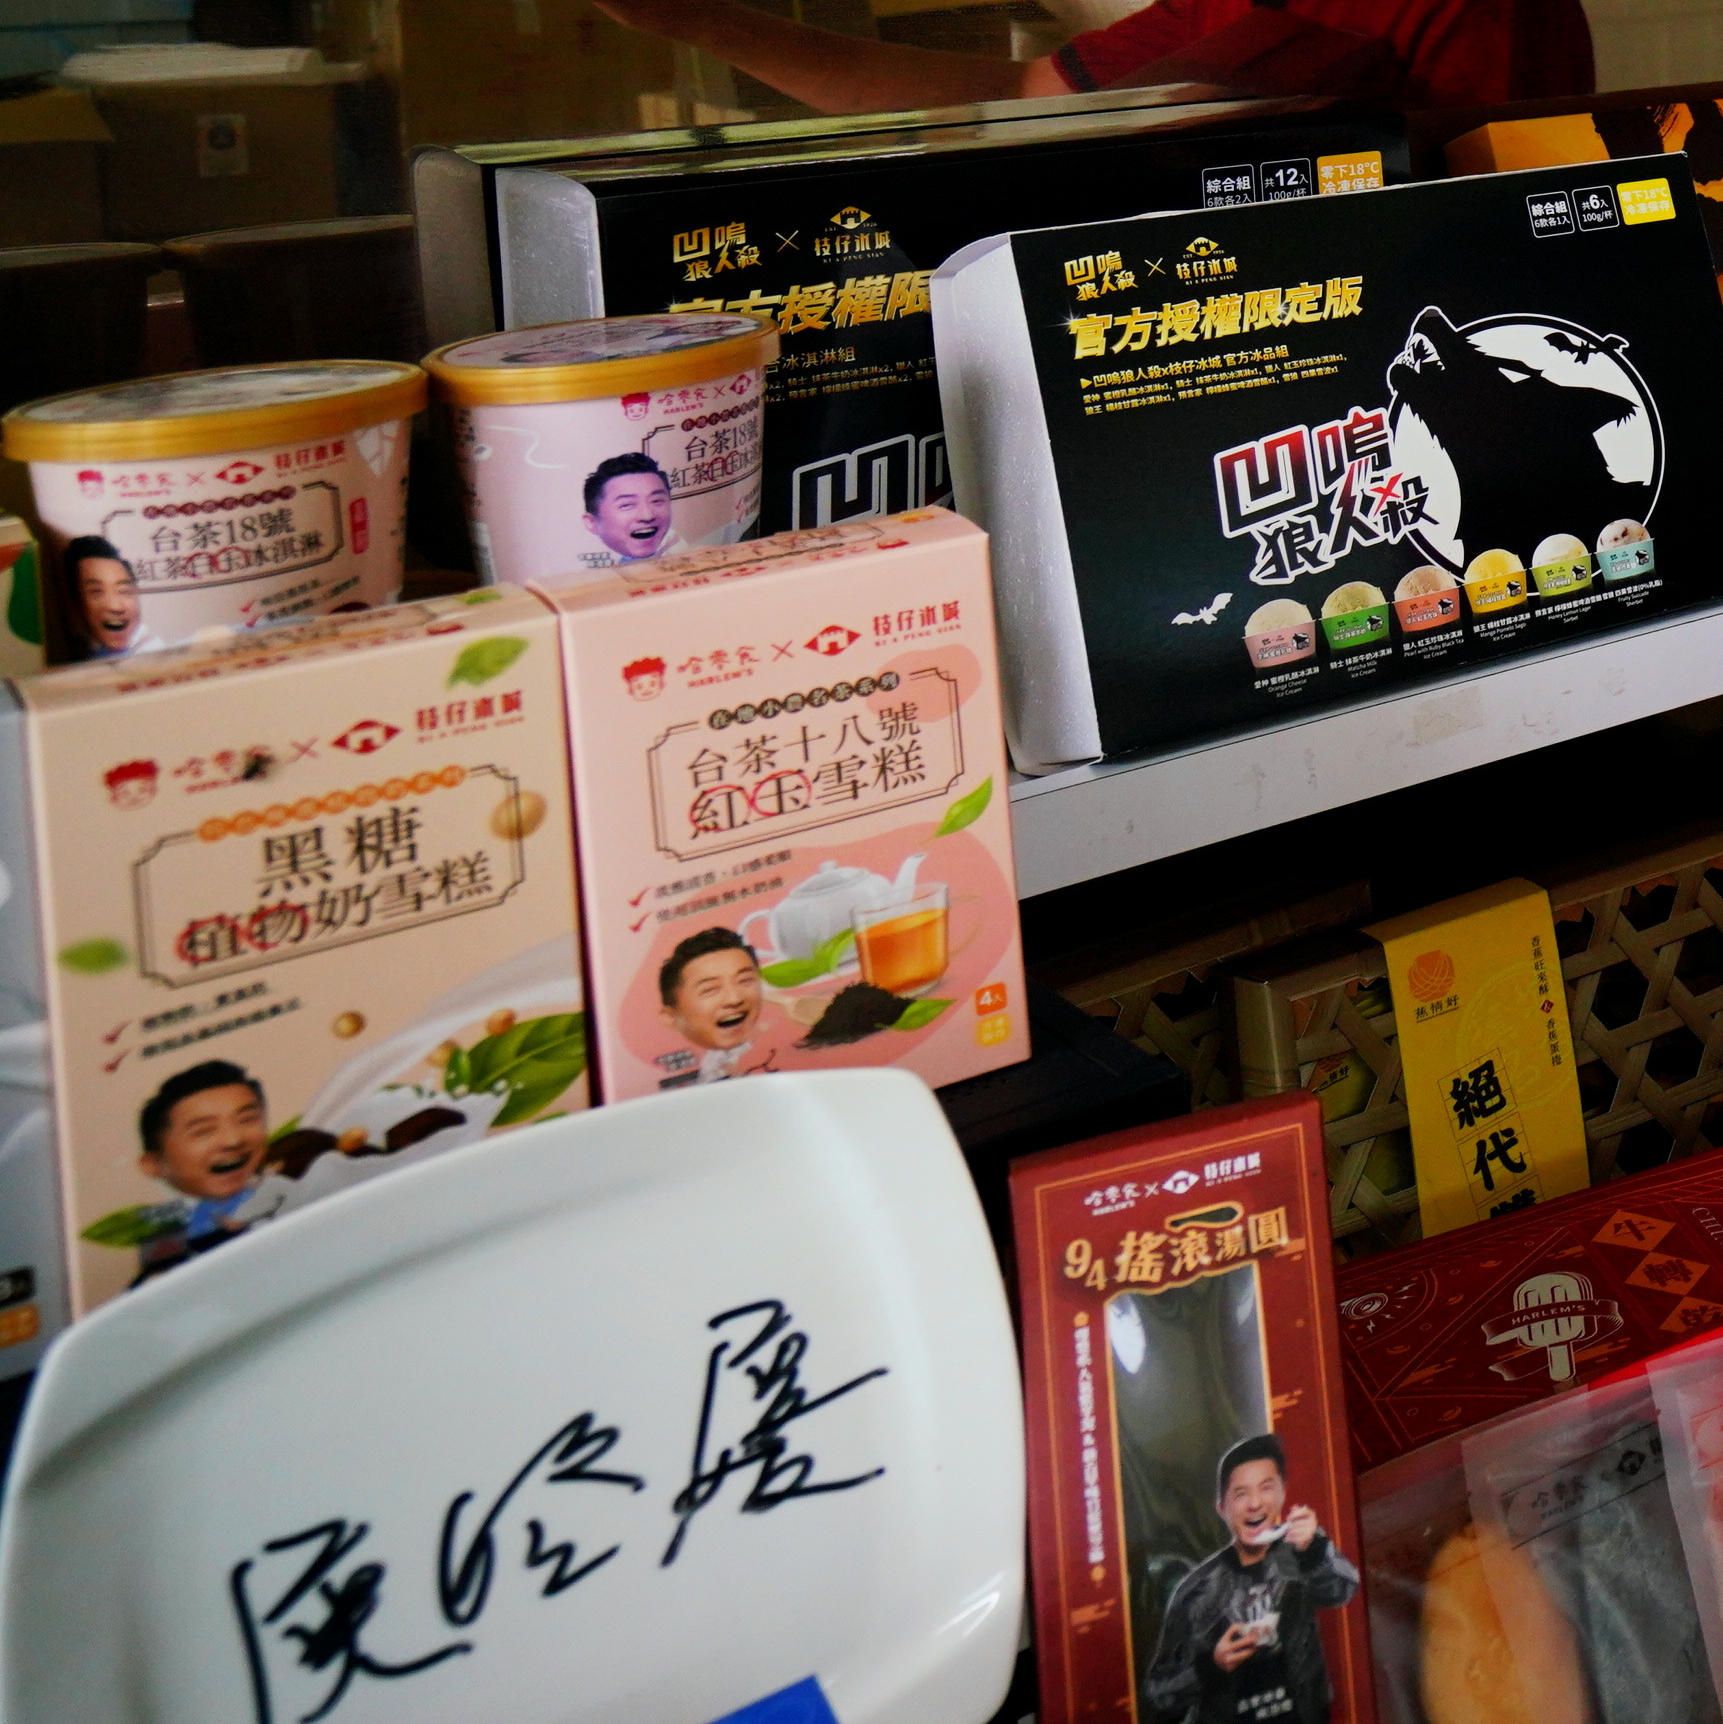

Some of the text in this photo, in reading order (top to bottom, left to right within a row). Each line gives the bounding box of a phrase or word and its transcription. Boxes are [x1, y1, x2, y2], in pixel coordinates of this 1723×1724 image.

[1206, 176, 1251, 194] 綜合組
[1265, 168, 1309, 188] 共12入
[1531, 201, 1568, 217] 綜合組
[1582, 194, 1609, 211] 共6入
[1534, 215, 1571, 228] 6款各1入
[1582, 210, 1613, 223] 100g/杯
[814, 230, 892, 257] 枝仔冰城
[1175, 256, 1239, 280] 枝仔冰城
[1069, 276, 1363, 360] 官方授權限定版
[1224, 344, 1290, 368] 官方冰品組
[152, 508, 296, 553] 台茶18號
[686, 702, 922, 788] 台茶十八號
[689, 739, 926, 840] 紅玉雪糕
[258, 806, 423, 898] 黑糖
[176, 851, 494, 966] 植物奶雪糕
[1065, 1206, 1290, 1291] 94搖滾湯圓
[1511, 1302, 1587, 1326] HARLEM'S
